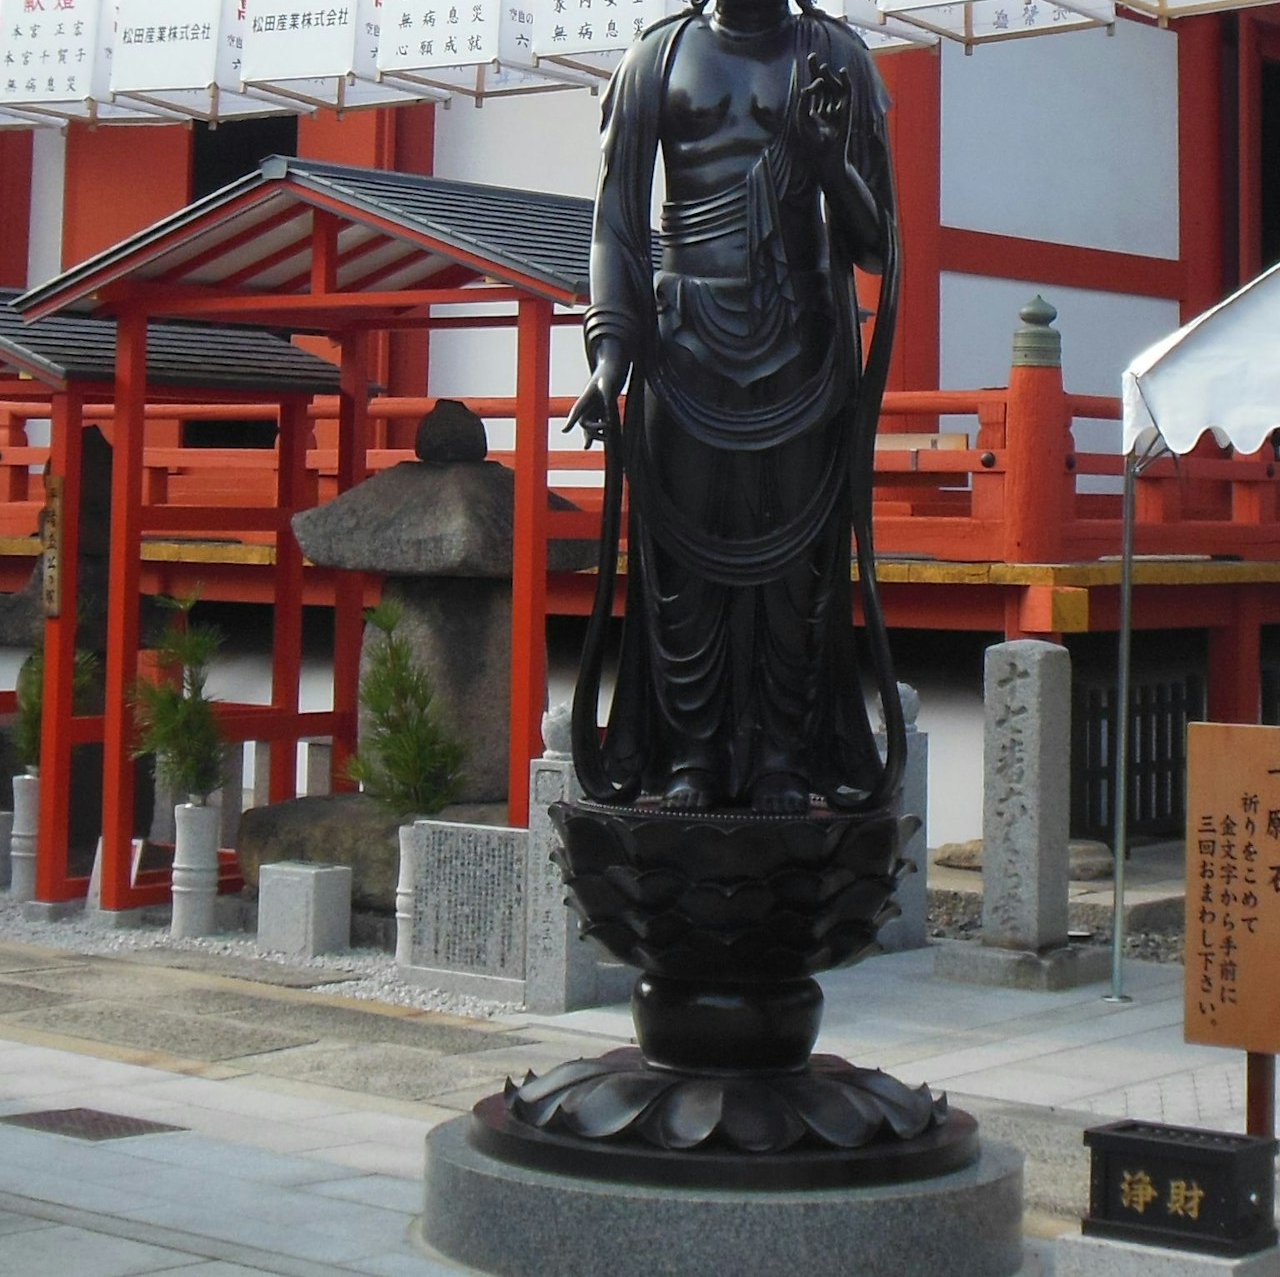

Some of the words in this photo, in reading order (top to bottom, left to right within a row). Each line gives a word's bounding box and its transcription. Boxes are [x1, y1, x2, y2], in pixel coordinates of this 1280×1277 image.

[252, 7, 349, 33] 松田産業株式会社
[398, 4, 485, 29] 無病息災
[122, 22, 212, 45] 松田産業株式会社
[395, 35, 483, 56] 心願成就
[1241, 791, 1261, 935] 祈りをこめて
[1197, 815, 1218, 1028] 三回おまわし下さい。
[1219, 814, 1239, 1005] 金文字から手前に
